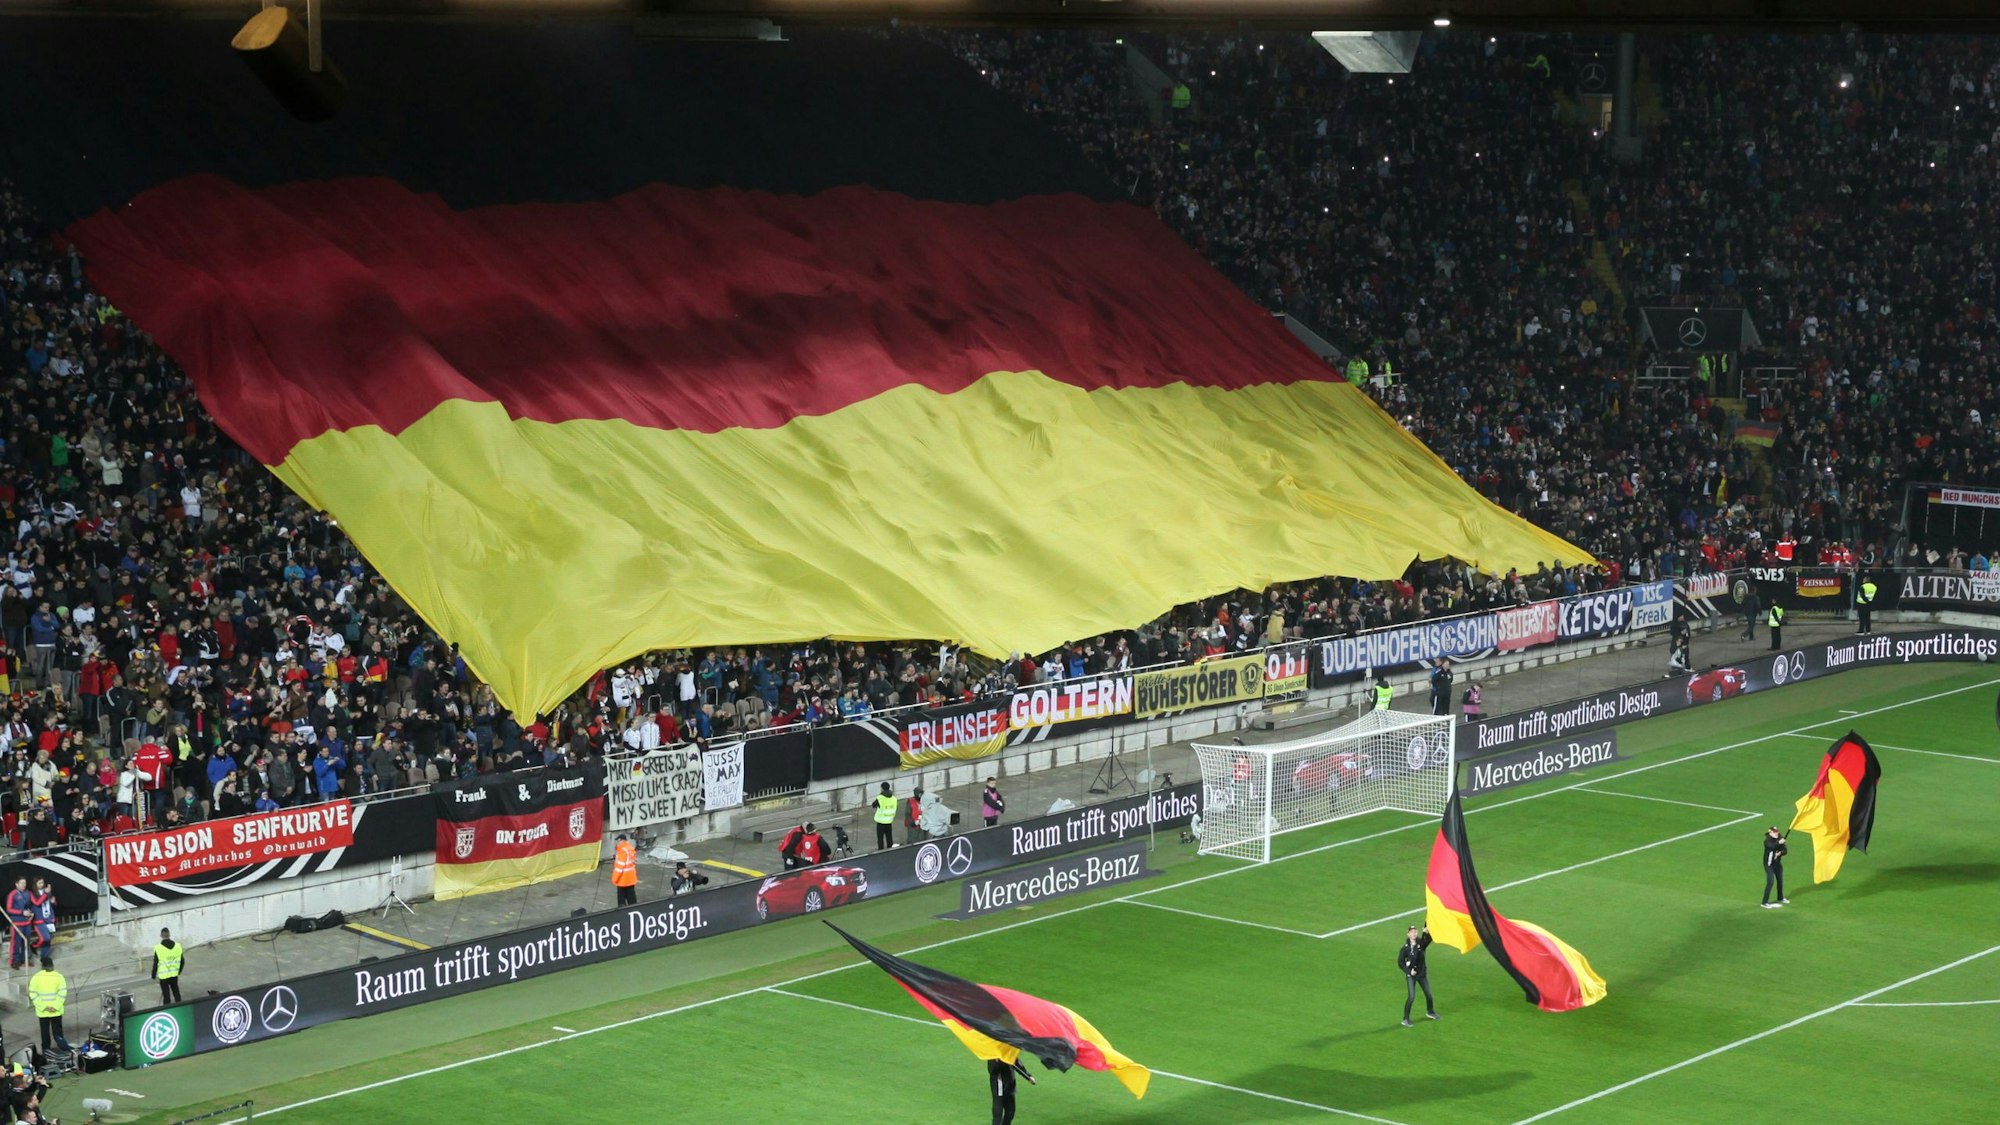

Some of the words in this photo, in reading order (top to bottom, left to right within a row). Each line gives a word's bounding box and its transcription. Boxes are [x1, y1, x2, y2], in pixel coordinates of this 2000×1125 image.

[1943, 491, 1960, 502] RED
[1803, 578, 1835, 587] ZEISKAM
[1557, 590, 1632, 637] KETSCH
[1636, 605, 1668, 626] Freak
[1826, 644, 1855, 668] Raum
[1858, 636, 1891, 661] trifft
[1896, 633, 1997, 662] sportliches
[1011, 677, 1133, 727] GOLTERN
[1138, 665, 1237, 713] RUHESTÖRER
[908, 708, 998, 754] ERLENSEE
[1477, 723, 1513, 750] Raum
[1518, 711, 1548, 739] trifft
[1550, 698, 1616, 737] sportliches
[1619, 689, 1661, 719] Design.
[608, 760, 633, 782] MATT
[642, 754, 675, 776] GREETS
[671, 769, 702, 792] CRAZY
[716, 762, 742, 782] MAX
[1472, 738, 1613, 792] Mercedes-Benz
[455, 787, 487, 803] Frank
[518, 784, 531, 801] &
[547, 777, 584, 793] Dietmar
[617, 804, 635, 825] MY
[638, 797, 677, 821] SWEET
[109, 827, 213, 866] INVASION
[233, 804, 349, 846] SENFKURVE
[495, 830, 516, 844] ON
[518, 823, 550, 844] TOUR
[1011, 826, 1062, 856] Raum
[1066, 808, 1107, 842] trifft
[1110, 791, 1198, 839] sportliches
[138, 864, 167, 878] Red
[263, 836, 327, 855] Odenwald
[967, 853, 1140, 913] Mercedes-Benz
[355, 966, 426, 1006] Raum
[434, 945, 491, 987] trifft
[498, 921, 621, 979] sportliches
[628, 903, 708, 944] Design.
